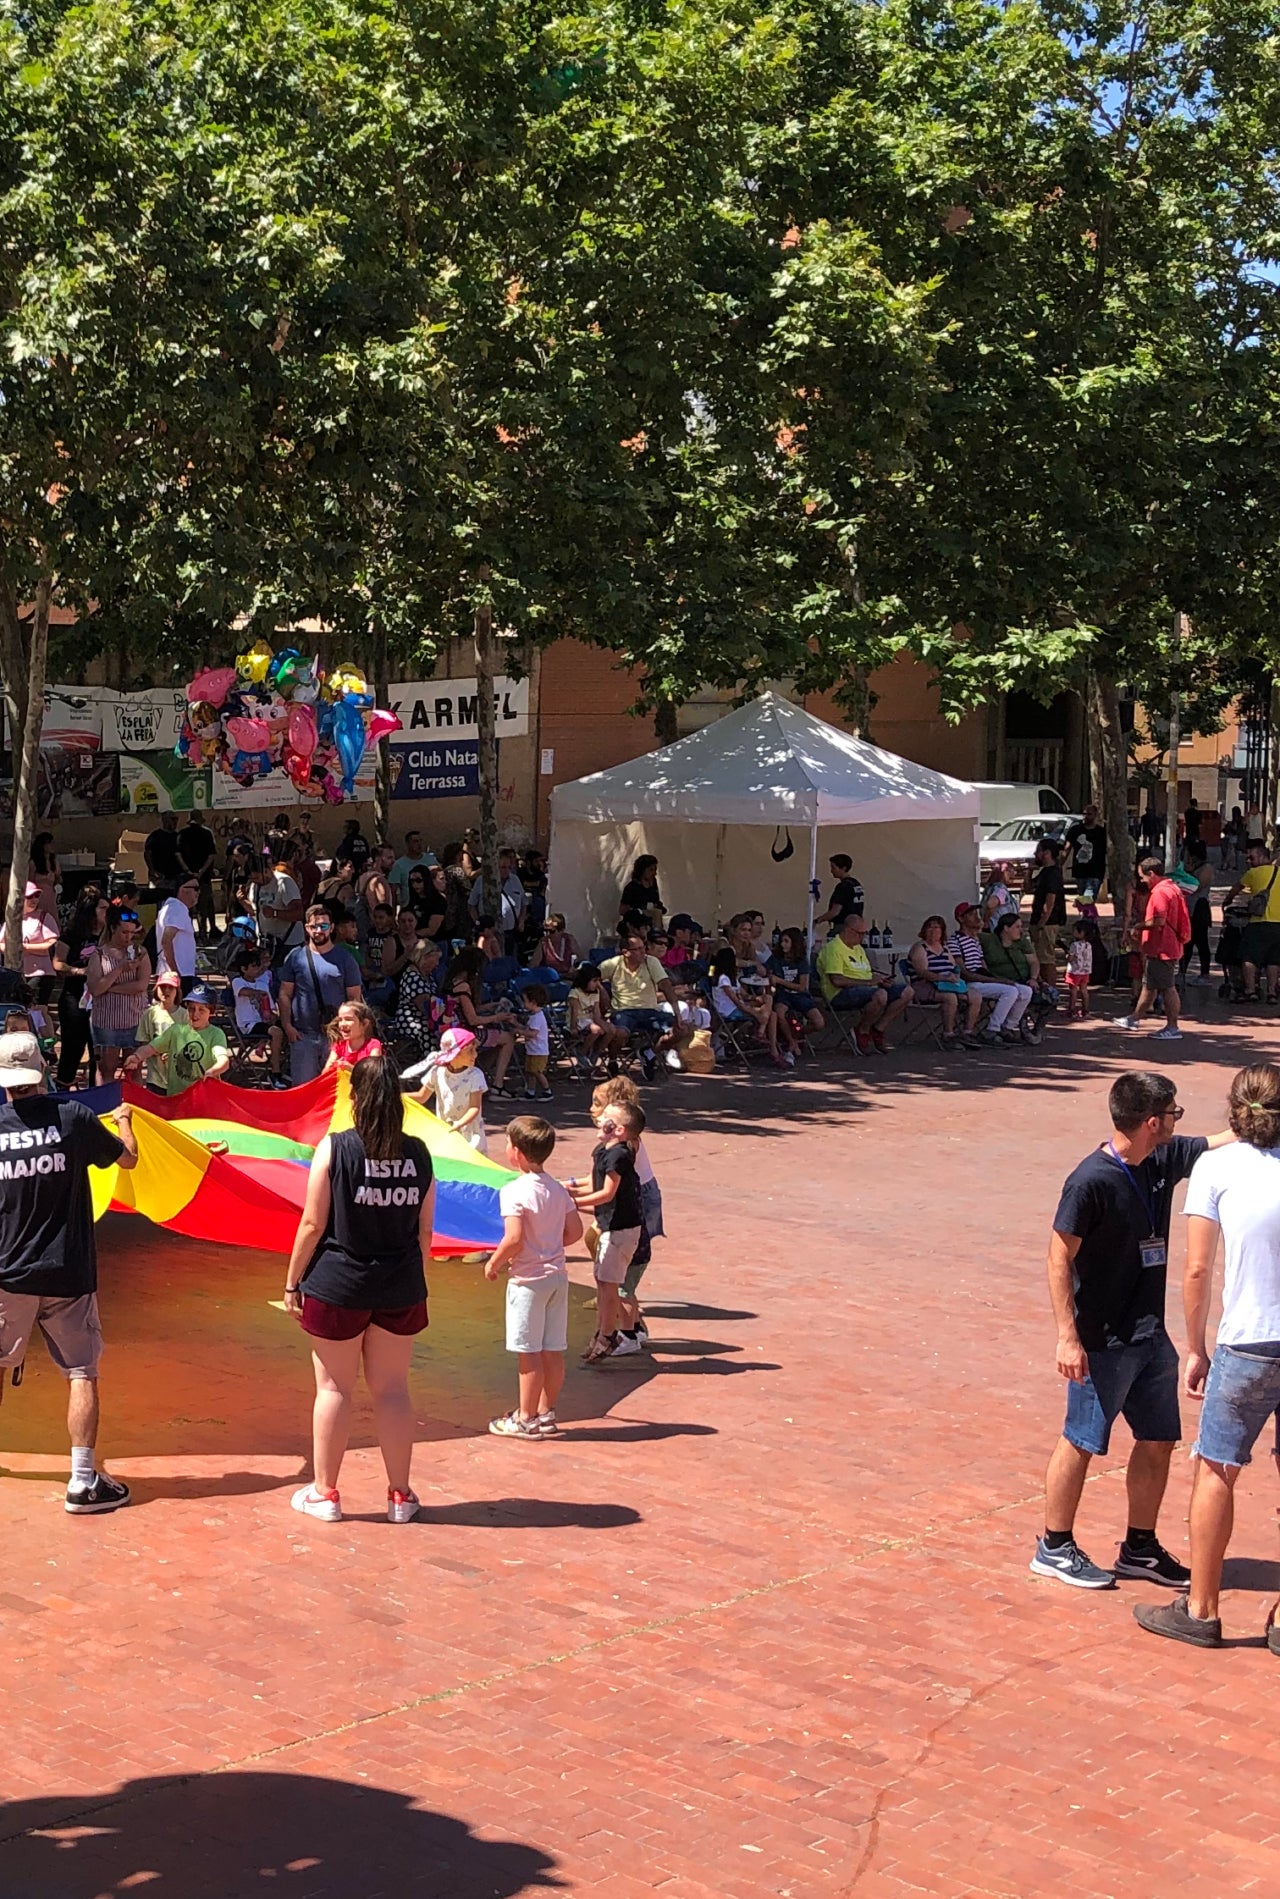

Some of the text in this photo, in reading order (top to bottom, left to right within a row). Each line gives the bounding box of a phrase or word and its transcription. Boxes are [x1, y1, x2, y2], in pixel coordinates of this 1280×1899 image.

[408, 749, 480, 768] Club Nata
[409, 774, 466, 791] Terrassa
[0, 1125, 62, 1152] FESTA
[354, 1185, 420, 1207] MAJOR
